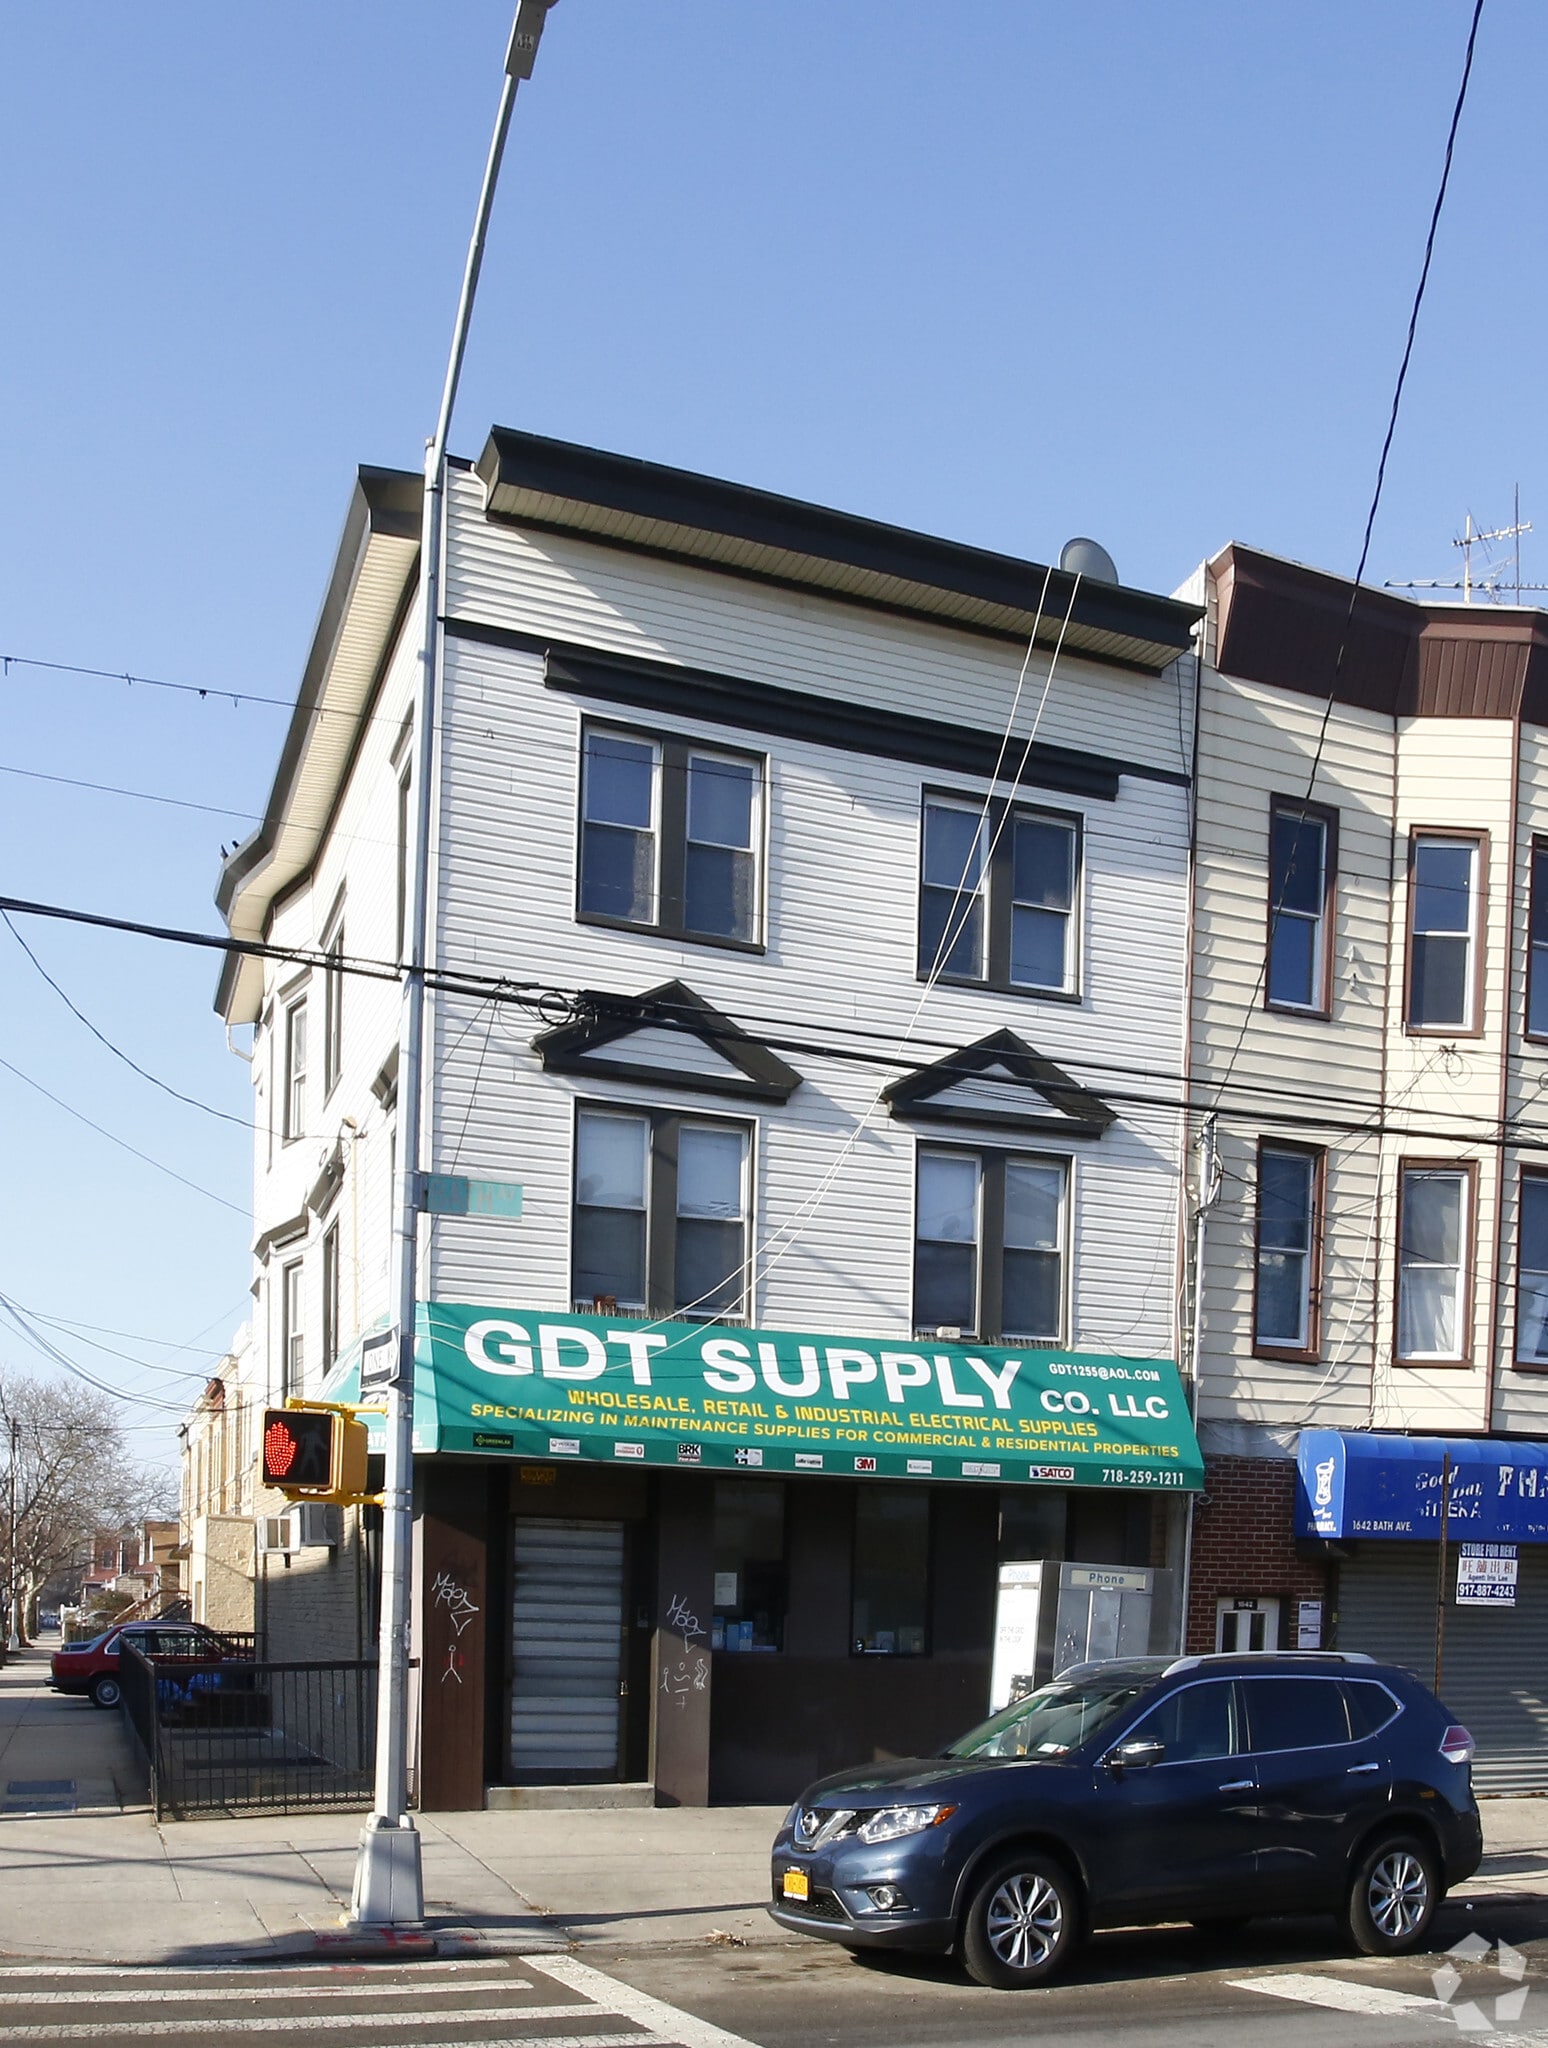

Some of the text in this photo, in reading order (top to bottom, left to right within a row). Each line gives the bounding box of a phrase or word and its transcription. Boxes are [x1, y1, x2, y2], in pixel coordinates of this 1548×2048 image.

[464, 1319, 1022, 1409] GDT SUPPLY
[1049, 1363, 1160, 1382] GDT1255@AOL.COM
[1040, 1390, 1169, 1419] CO. LLC
[703, 1400, 768, 1418] RETAIL
[775, 1405, 788, 1419] &
[795, 1406, 903, 1427] INDUSTRIAL
[909, 1413, 1013, 1433] ELECTRICAL
[1020, 1419, 1098, 1437] SUPPLIES
[471, 1403, 1179, 1457] SPECIALIZING IN MAINTENANCE SUPPLIES FOR COMMERCIAL & RESIDENTIAL PROPERTIES
[679, 1444, 699, 1455] BRK
[856, 1458, 875, 1470] 3M
[1040, 1467, 1072, 1479] SATCO
[1102, 1469, 1184, 1485] 718-259-1211
[1352, 1520, 1412, 1532] 1642 BATH AVE.
[1462, 1543, 1517, 1558] STORE FOR RENT
[1088, 1572, 1125, 1585] Phone
[1459, 1584, 1515, 1598] 917-887-4243
